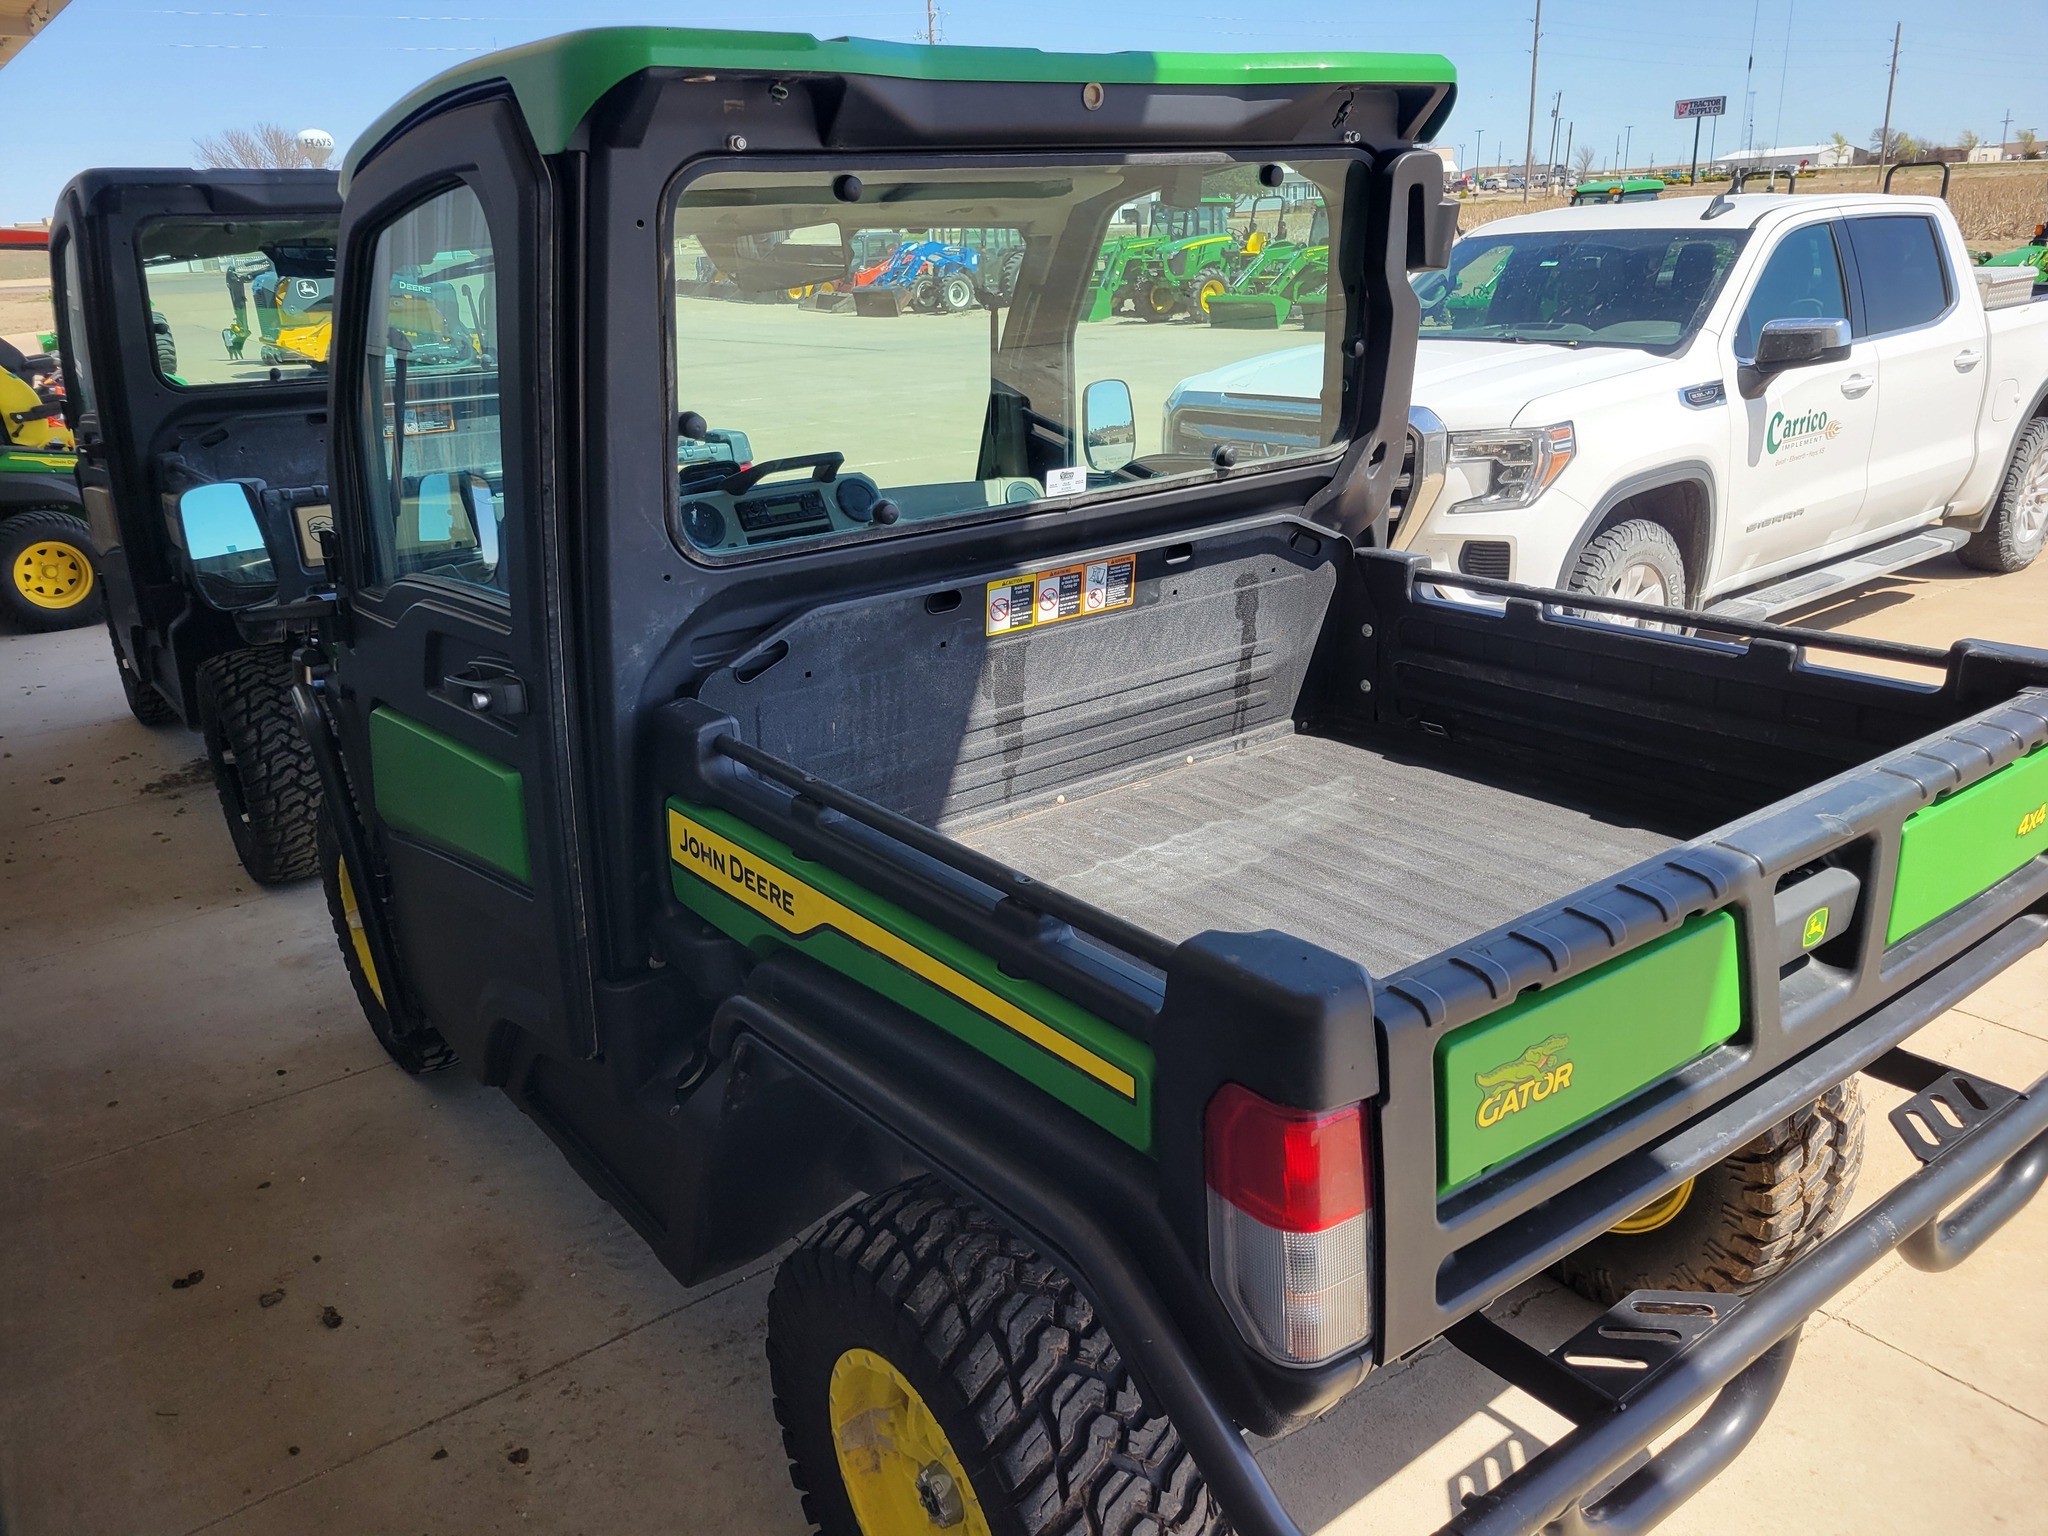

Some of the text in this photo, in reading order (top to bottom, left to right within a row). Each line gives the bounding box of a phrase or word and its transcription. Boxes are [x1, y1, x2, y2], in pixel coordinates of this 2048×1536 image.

[1689, 99, 1720, 108] TRACTOR
[1688, 107, 1712, 115] SUPPLY
[304, 138, 332, 148] HAYS
[399, 281, 432, 294] DEERE
[1767, 409, 1828, 455] Carrico
[1781, 435, 1823, 451] IMPLEMENT
[1745, 508, 1805, 534] SIERRA
[1005, 578, 1023, 586] CAUTION
[680, 828, 795, 916] JOHN DEERE
[1478, 1061, 1574, 1128] GATOR
